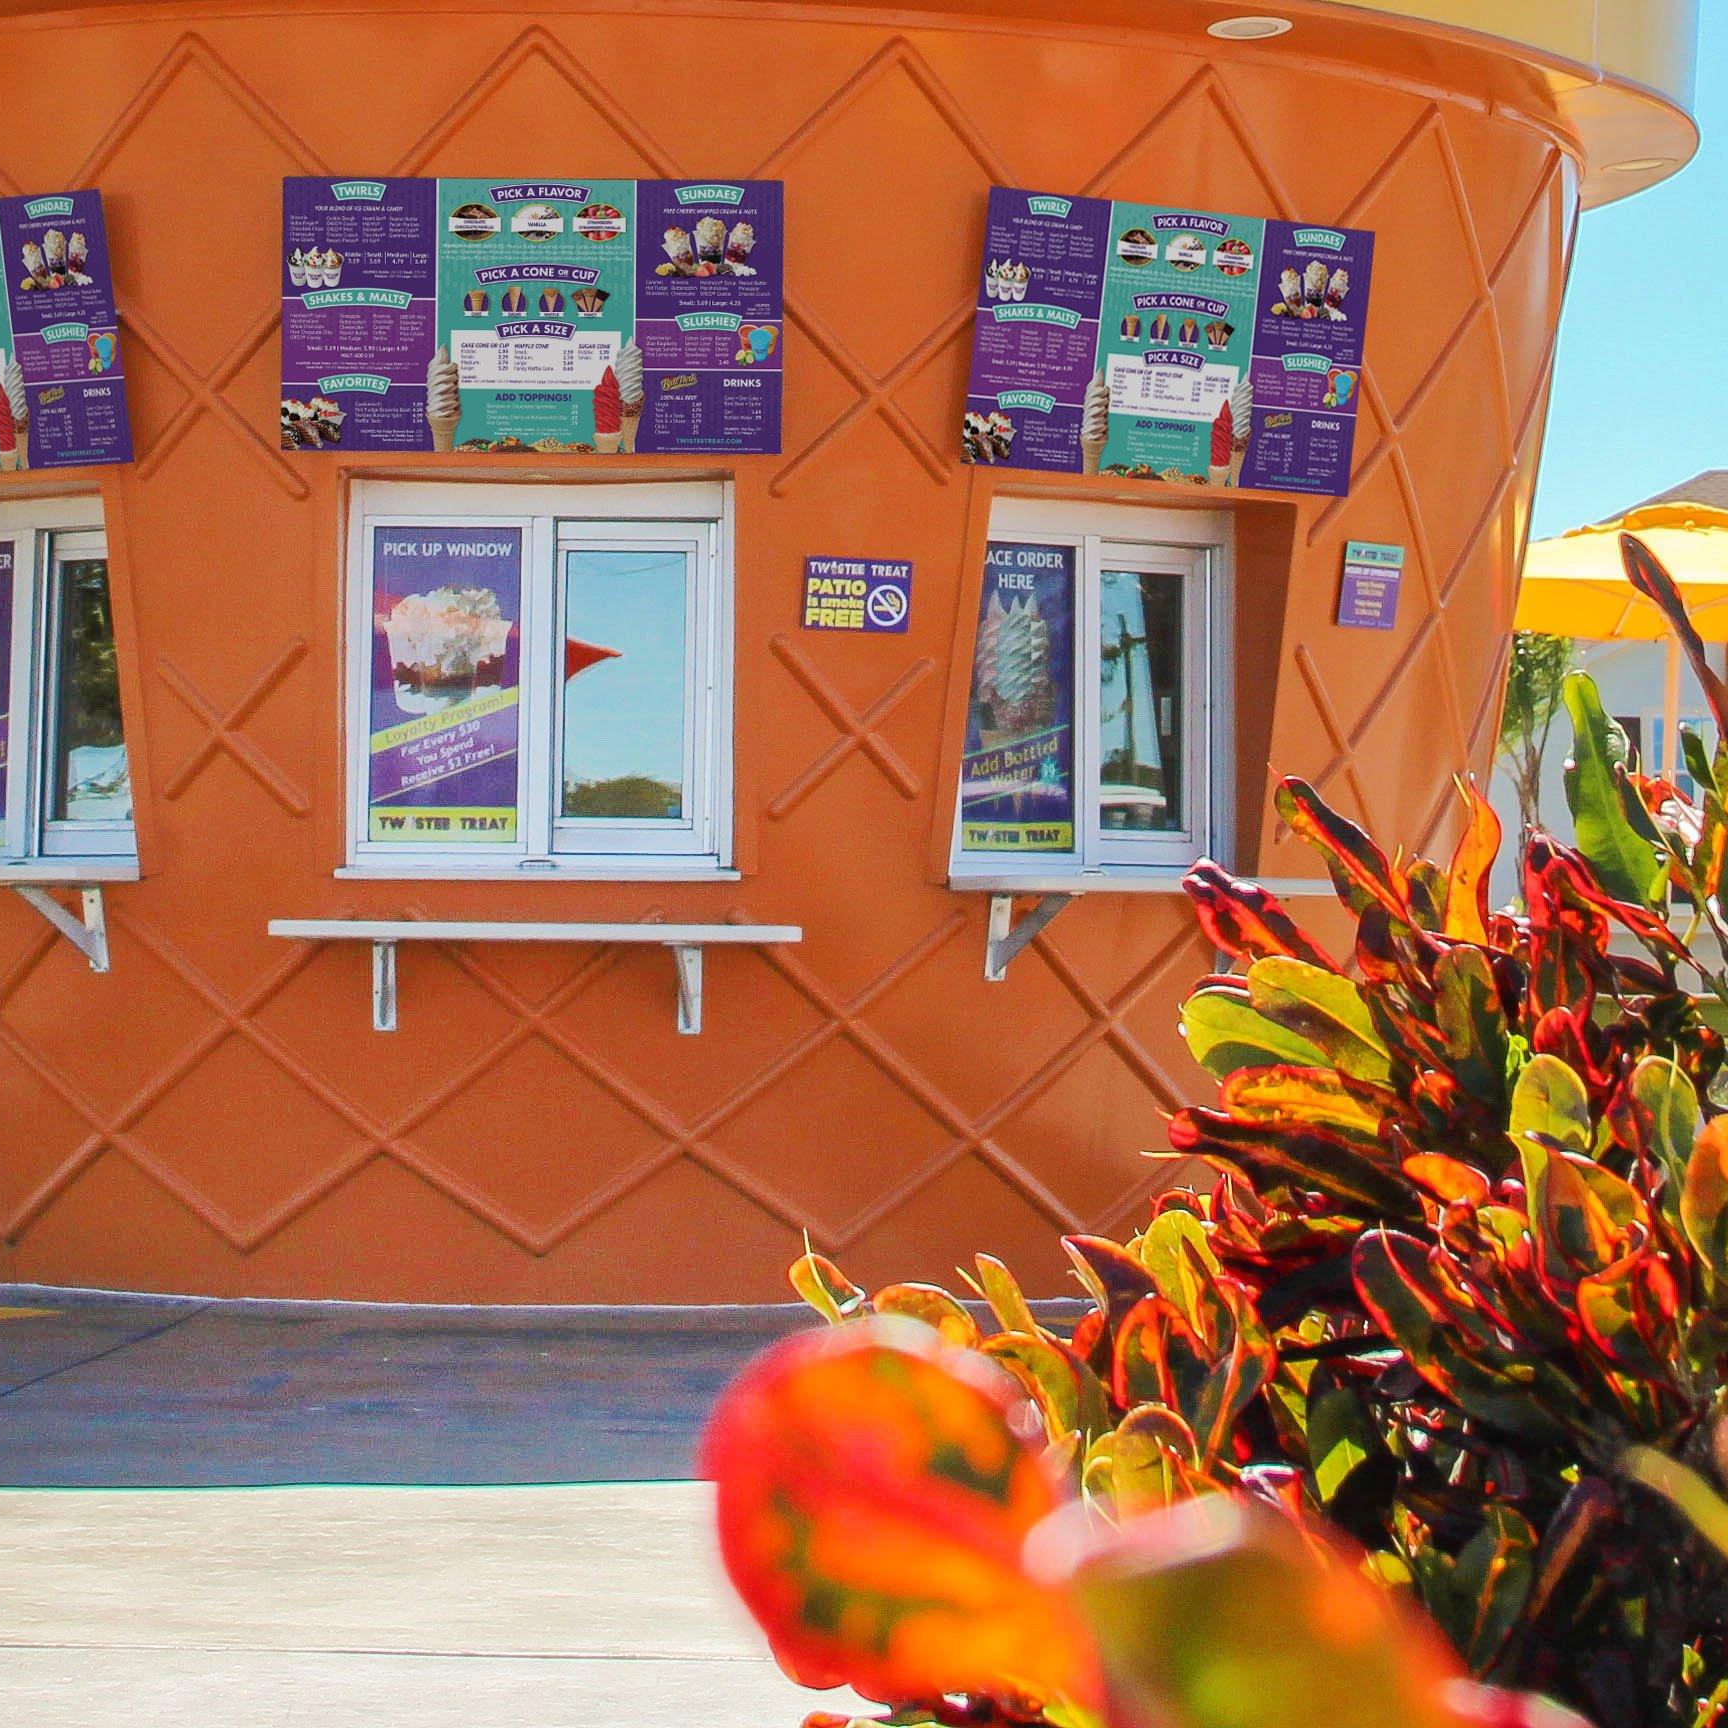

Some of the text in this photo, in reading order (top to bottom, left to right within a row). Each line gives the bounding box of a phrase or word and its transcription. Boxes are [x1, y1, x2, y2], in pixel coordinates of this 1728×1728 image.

[338, 186, 380, 196] TWIRLS
[497, 188, 581, 200] PICK A FLAVOR
[682, 190, 737, 200] SUNDAES
[30, 202, 69, 214] SUNDAES
[1033, 201, 1067, 214] TWIRLS
[1158, 217, 1223, 232] PICK A FLAVOR
[1299, 233, 1341, 246] SUNDAES
[481, 269, 507, 281] PICK
[511, 268, 519, 276] A
[522, 267, 554, 277] CONE
[572, 269, 595, 280] CUP
[309, 293, 353, 305] SHAKES
[369, 293, 405, 304] MALTS
[1137, 297, 1158, 307] PICK
[1160, 297, 1167, 306] A
[1170, 297, 1194, 307] CONE
[1207, 302, 1225, 313] CUP
[683, 317, 736, 327] SLUSHIES
[998, 307, 1076, 324] SHAKES & MALTS
[46, 328, 85, 339] SLUSHIES
[503, 324, 568, 335] PICK A SIZE
[1148, 353, 1199, 367] PICK A SIZE
[1287, 357, 1327, 370] SLUSHIES
[324, 378, 385, 390] FAVORITES
[723, 379, 761, 387] DRINKS
[83, 387, 111, 397] DRINKS
[1001, 395, 1051, 408] FAVORITES
[1136, 420, 1196, 433] ADD TOPPINGS!
[1311, 421, 1341, 431] DRINKS
[383, 543, 513, 557] PICK UP WINDOW
[985, 551, 1063, 568] ACE ORDER
[870, 565, 908, 578] TREAT
[808, 578, 866, 596] PATIO
[998, 574, 1034, 589] HERE
[806, 608, 864, 628] FREE
[386, 720, 436, 743] Loyalty
[401, 744, 420, 757] For
[423, 731, 456, 749] Every
[416, 737, 474, 765] You Spend
[401, 765, 445, 786] Receive
[464, 744, 495, 763] Free!
[971, 755, 999, 777] Add
[460, 817, 508, 830] TREAT
